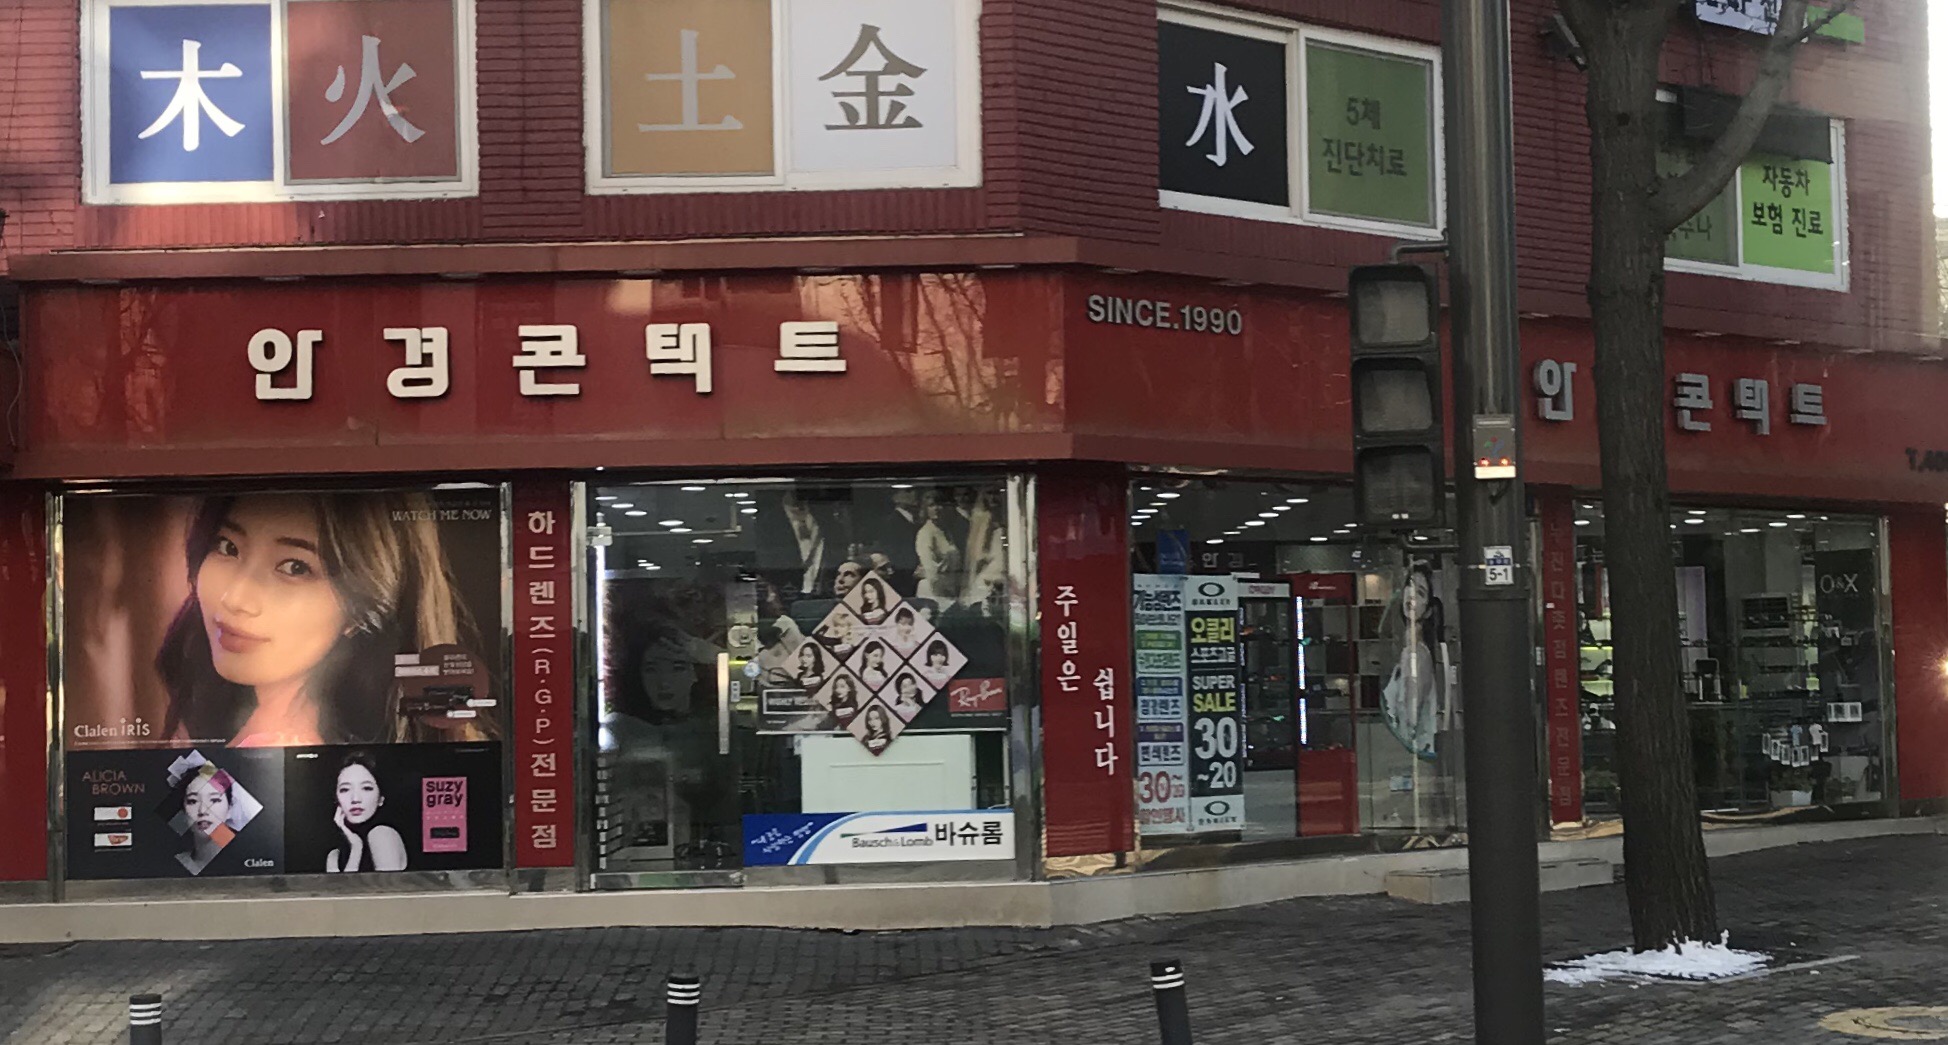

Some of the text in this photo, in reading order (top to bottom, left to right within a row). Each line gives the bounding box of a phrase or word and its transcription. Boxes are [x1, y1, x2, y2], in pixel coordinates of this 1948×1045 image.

[319, 34, 426, 147] 火
[637, 28, 744, 133] 土
[817, 23, 928, 131] 金
[138, 38, 246, 152] 木
[1185, 61, 1255, 167] 水
[1322, 137, 1408, 177] 진단치료
[1762, 164, 1811, 199] 자동차
[1751, 201, 1824, 239] 보험 진료
[1087, 294, 1243, 336] SINCE.1990
[391, 509, 492, 521] WATCH ME NOW
[1489, 567, 1509, 582] 5-1
[1054, 584, 1081, 692] 주일은
[1190, 616, 1236, 643] 오클리
[1191, 674, 1236, 691] SUPER
[1192, 691, 1237, 713] SALE
[73, 724, 117, 738] Clalen
[1093, 667, 1119, 776] 쉽니다
[1193, 716, 1239, 760] 30
[82, 769, 127, 783] ALICIA
[92, 782, 145, 796] BROWN
[425, 780, 464, 795] suzy
[425, 793, 464, 808] gray
[935, 821, 1004, 847] 바슈롬
[243, 858, 275, 868] Clalen
